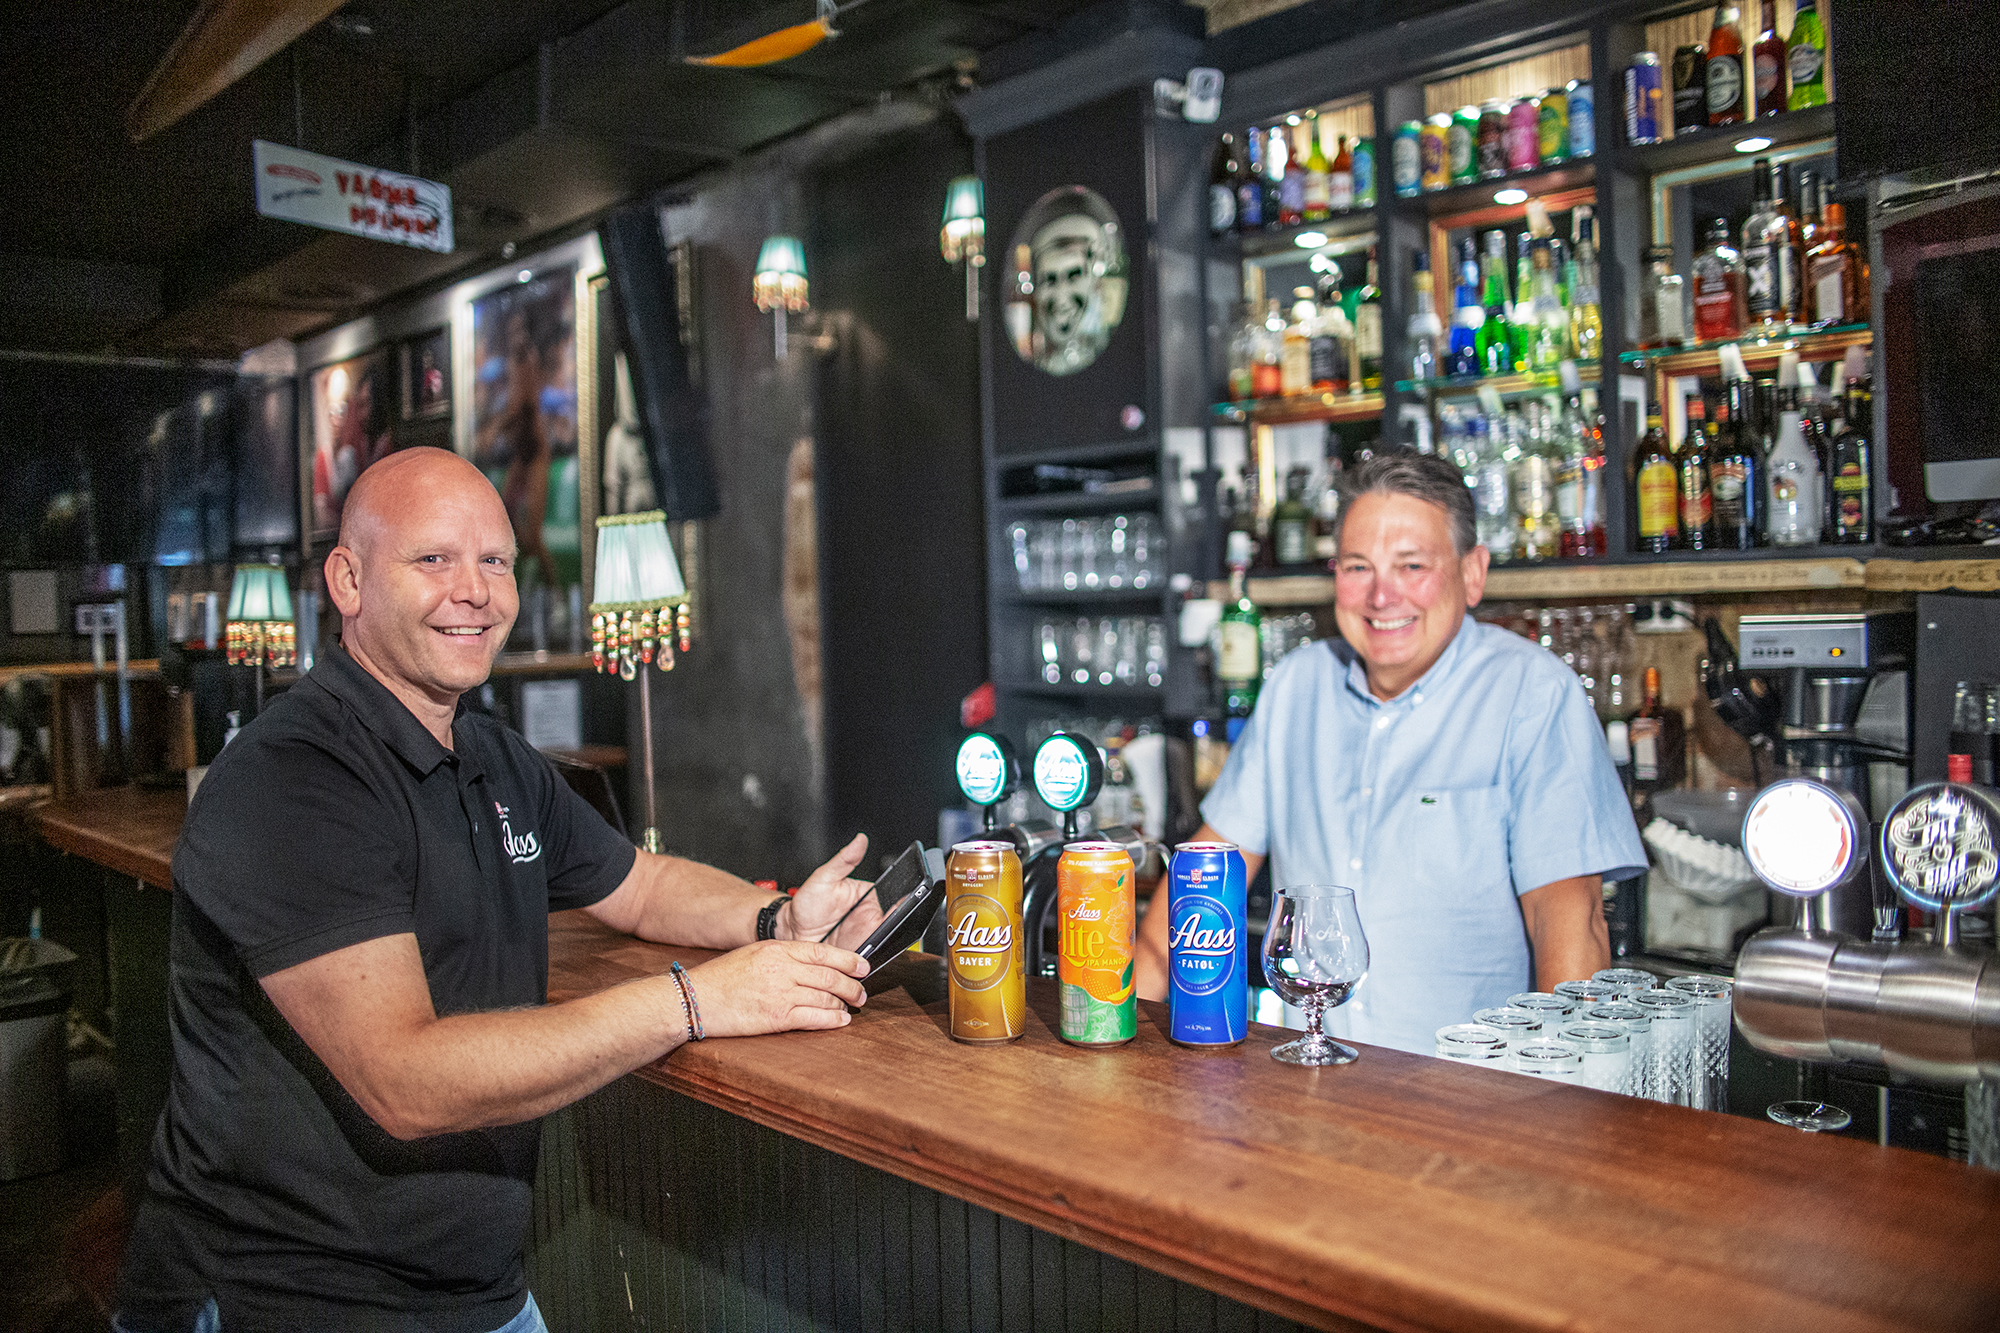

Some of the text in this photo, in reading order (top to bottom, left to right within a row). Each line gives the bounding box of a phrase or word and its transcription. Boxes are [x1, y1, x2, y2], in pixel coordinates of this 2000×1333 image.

[1068, 904, 1101, 922] Aass
[947, 911, 1013, 954] Aass
[1061, 911, 1105, 968] Lite
[1168, 913, 1236, 957] Aass
[959, 957, 992, 967] BAYER
[1087, 957, 1127, 967] IPA MANGO
[1182, 959, 1215, 970] FATØL
